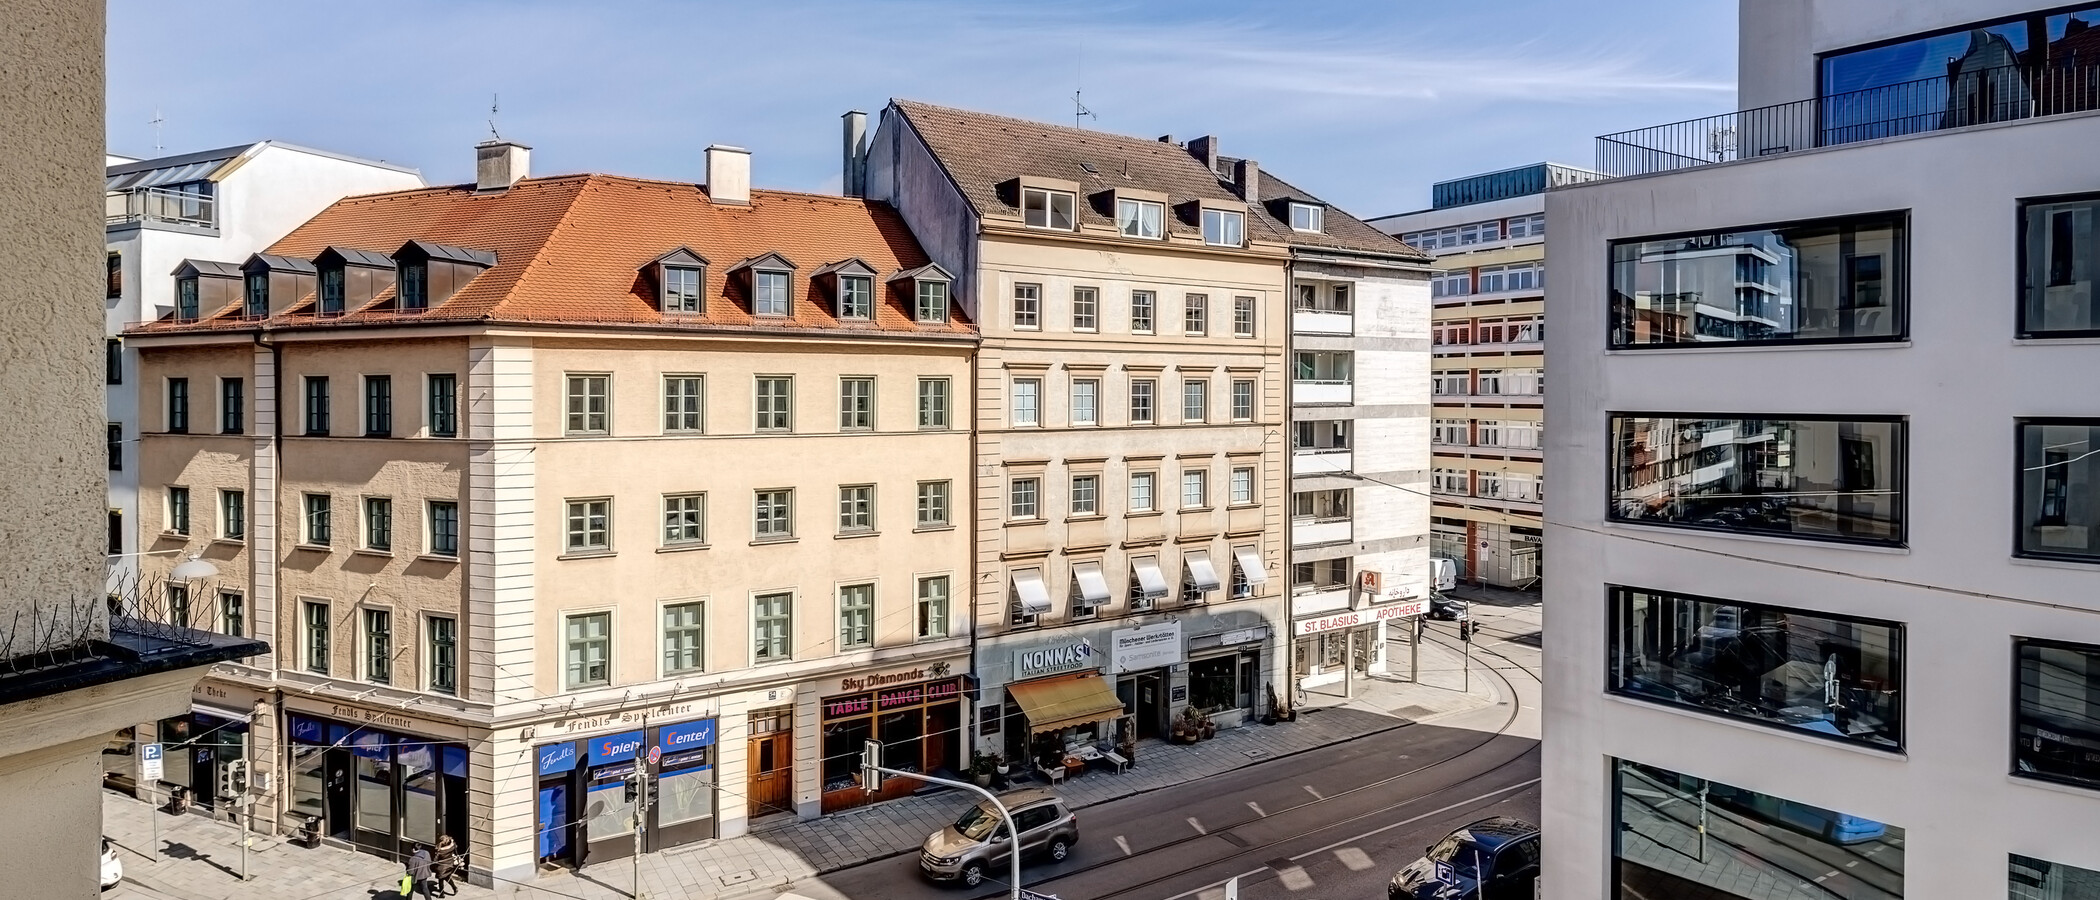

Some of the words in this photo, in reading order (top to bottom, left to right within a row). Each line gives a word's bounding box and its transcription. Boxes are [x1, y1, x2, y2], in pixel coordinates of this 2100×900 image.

[1305, 621, 1317, 633] ST.
[1320, 614, 1359, 630] BLASIUS
[1376, 603, 1421, 620] APOTHEKE
[1022, 644, 1085, 670] NONNA'S
[841, 677, 864, 692] Sky
[867, 669, 924, 687] Diamonds
[1022, 668, 1045, 677] ITALIAN
[207, 686, 227, 698] Theke
[830, 697, 868, 716] TABLE
[881, 689, 920, 707] DANCE
[928, 683, 957, 699] CLUB
[331, 705, 358, 718] Fendls
[364, 709, 412, 728] Spielcenter
[566, 717, 611, 733] Fendls
[621, 704, 692, 722] Spielcenter
[541, 747, 574, 770] Fendls
[601, 741, 635, 757] Spiel
[667, 730, 707, 746] Center
